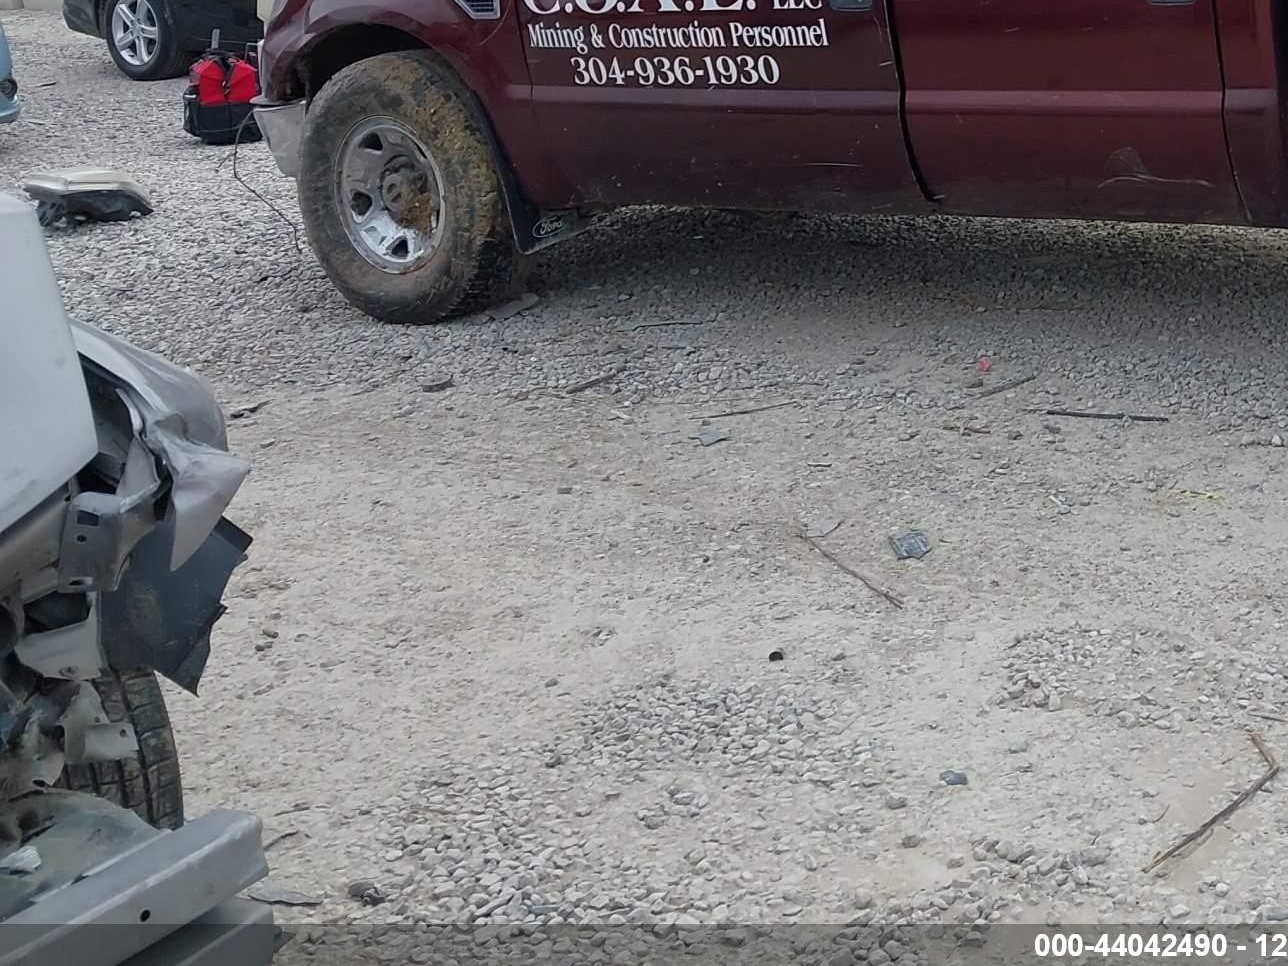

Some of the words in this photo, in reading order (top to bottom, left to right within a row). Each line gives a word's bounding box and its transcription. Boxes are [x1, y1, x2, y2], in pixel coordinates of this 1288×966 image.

[527, 23, 587, 53] Mining
[590, 23, 604, 48] &
[608, 21, 727, 48] Construction
[730, 18, 828, 46] Personnel
[571, 55, 779, 85] 304-936-1930
[540, 217, 562, 234] Ford
